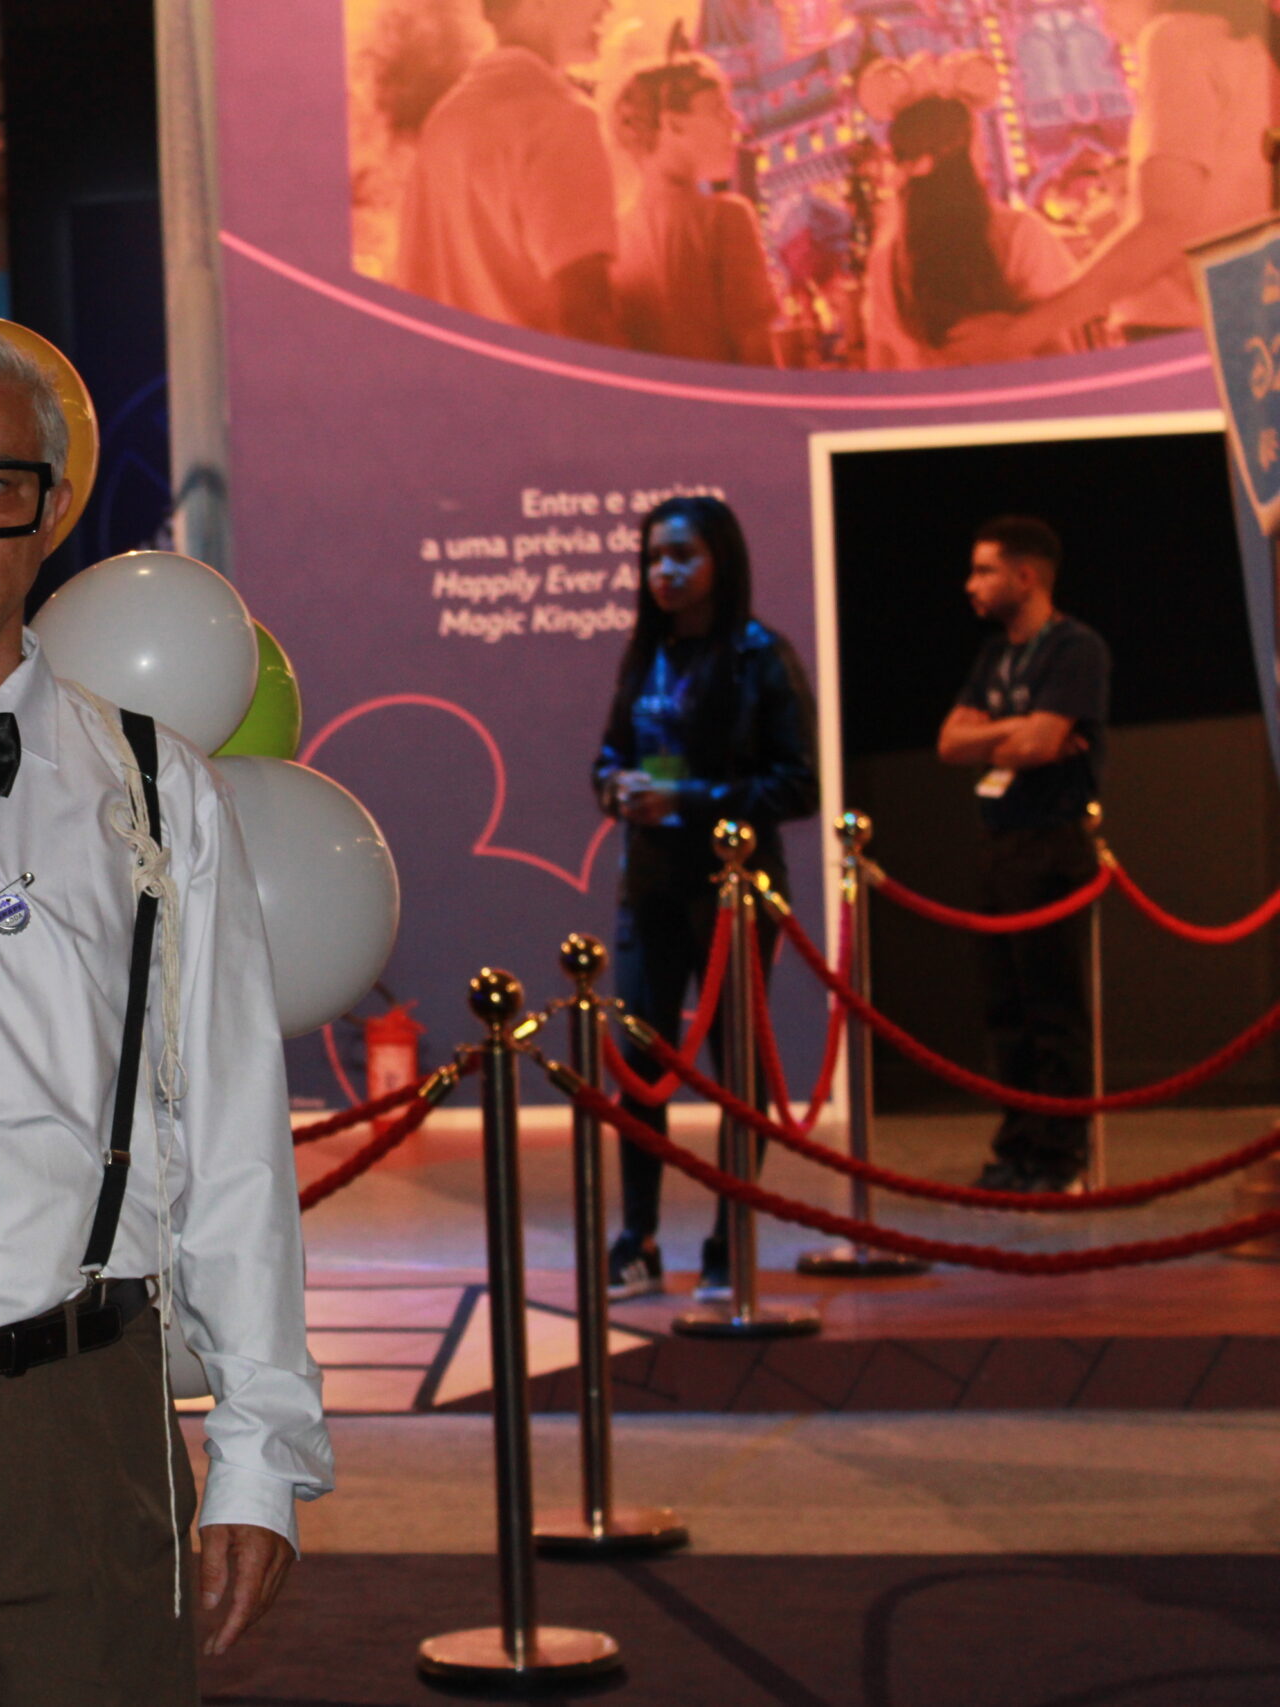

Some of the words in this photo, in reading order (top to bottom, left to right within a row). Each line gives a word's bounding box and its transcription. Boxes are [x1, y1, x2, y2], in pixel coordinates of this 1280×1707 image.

[521, 487, 599, 517] Entre
[605, 490, 625, 514] e
[420, 537, 440, 561] a
[445, 535, 507, 560] uma
[512, 527, 601, 562] prévia
[432, 566, 541, 603] Happily
[545, 563, 608, 595] Ever
[438, 606, 527, 644] Magic
[530, 601, 637, 641] Kingdo
